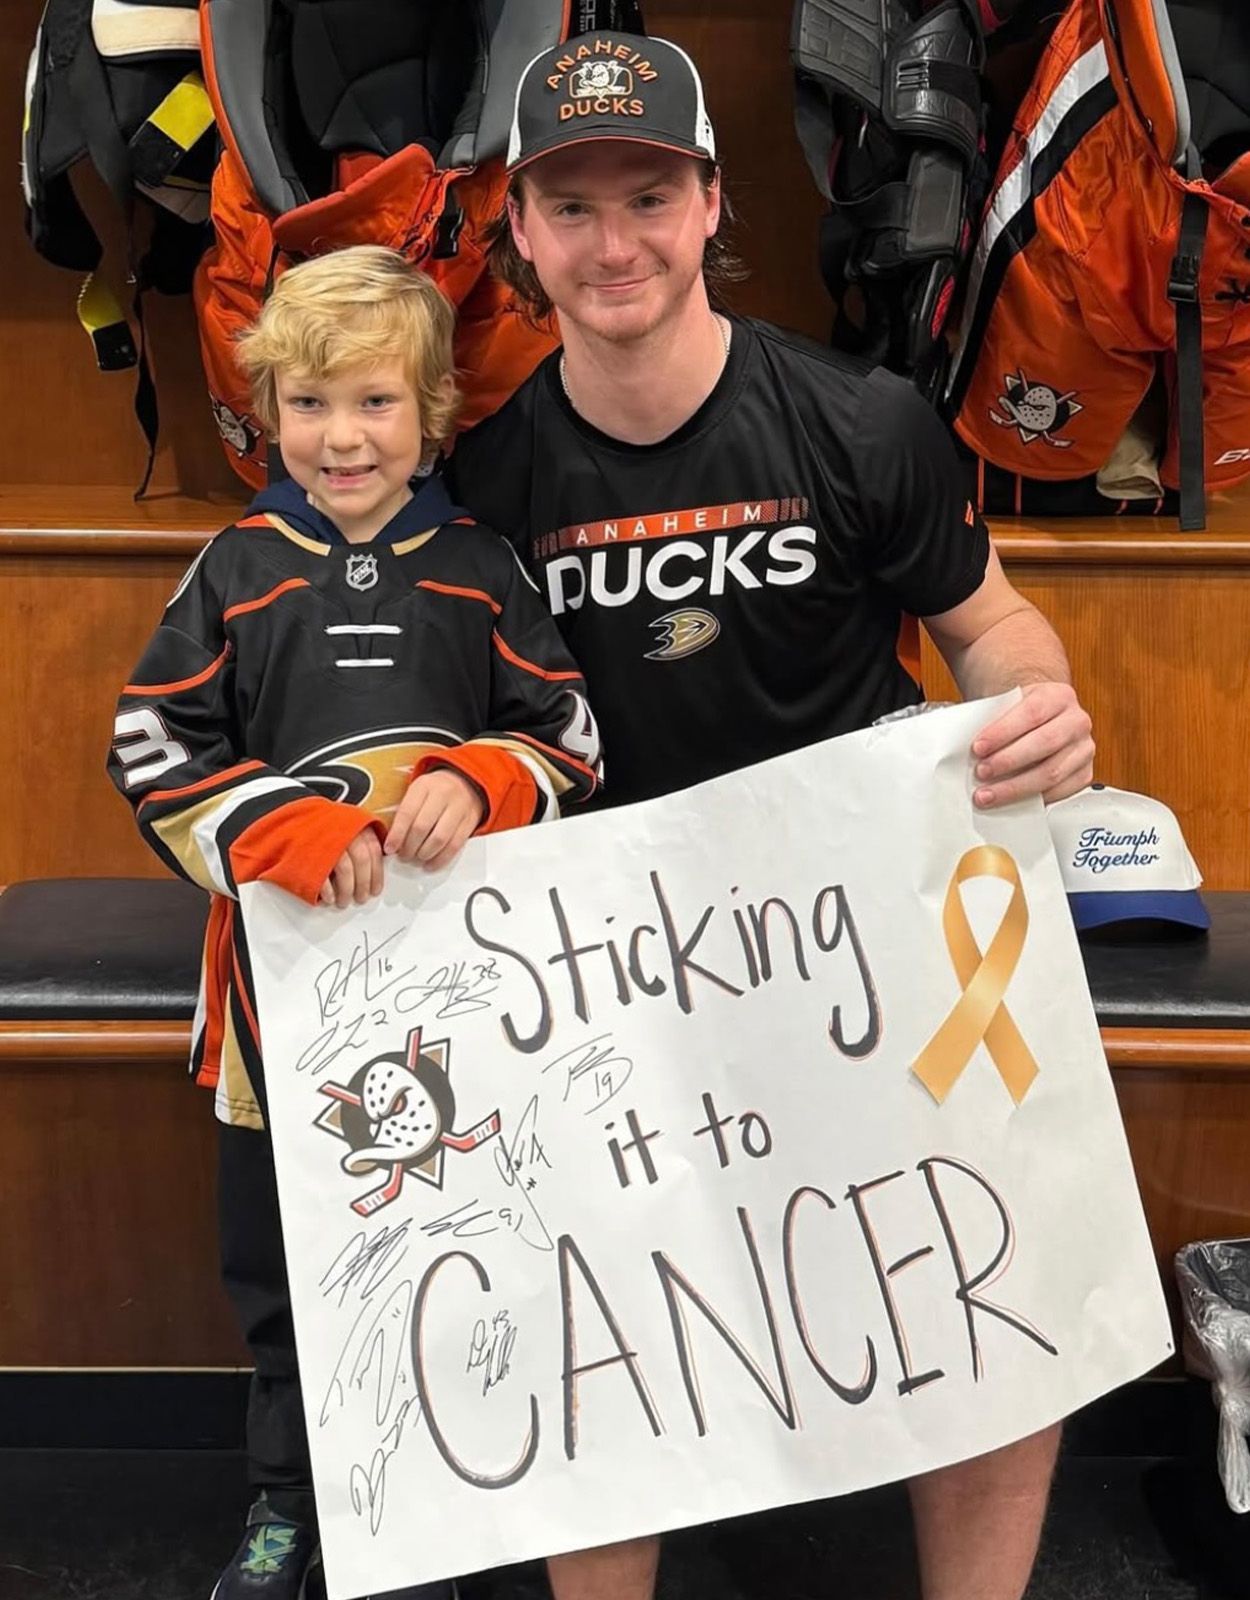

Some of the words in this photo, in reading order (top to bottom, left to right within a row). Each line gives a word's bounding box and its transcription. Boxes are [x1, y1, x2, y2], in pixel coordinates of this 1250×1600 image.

[546, 40, 658, 90] ANAHEIM
[559, 98, 644, 120] DUCKS
[576, 504, 762, 545] ANAHEIM
[546, 526, 817, 615] DUCKS
[112, 706, 192, 789] 3
[1072, 848, 1160, 874] Together
[1079, 826, 1160, 854] Triumph
[464, 870, 882, 1059] Sticking
[607, 1108, 661, 1188] it
[692, 1092, 772, 1168] to
[411, 1156, 1058, 1489] CANCER
